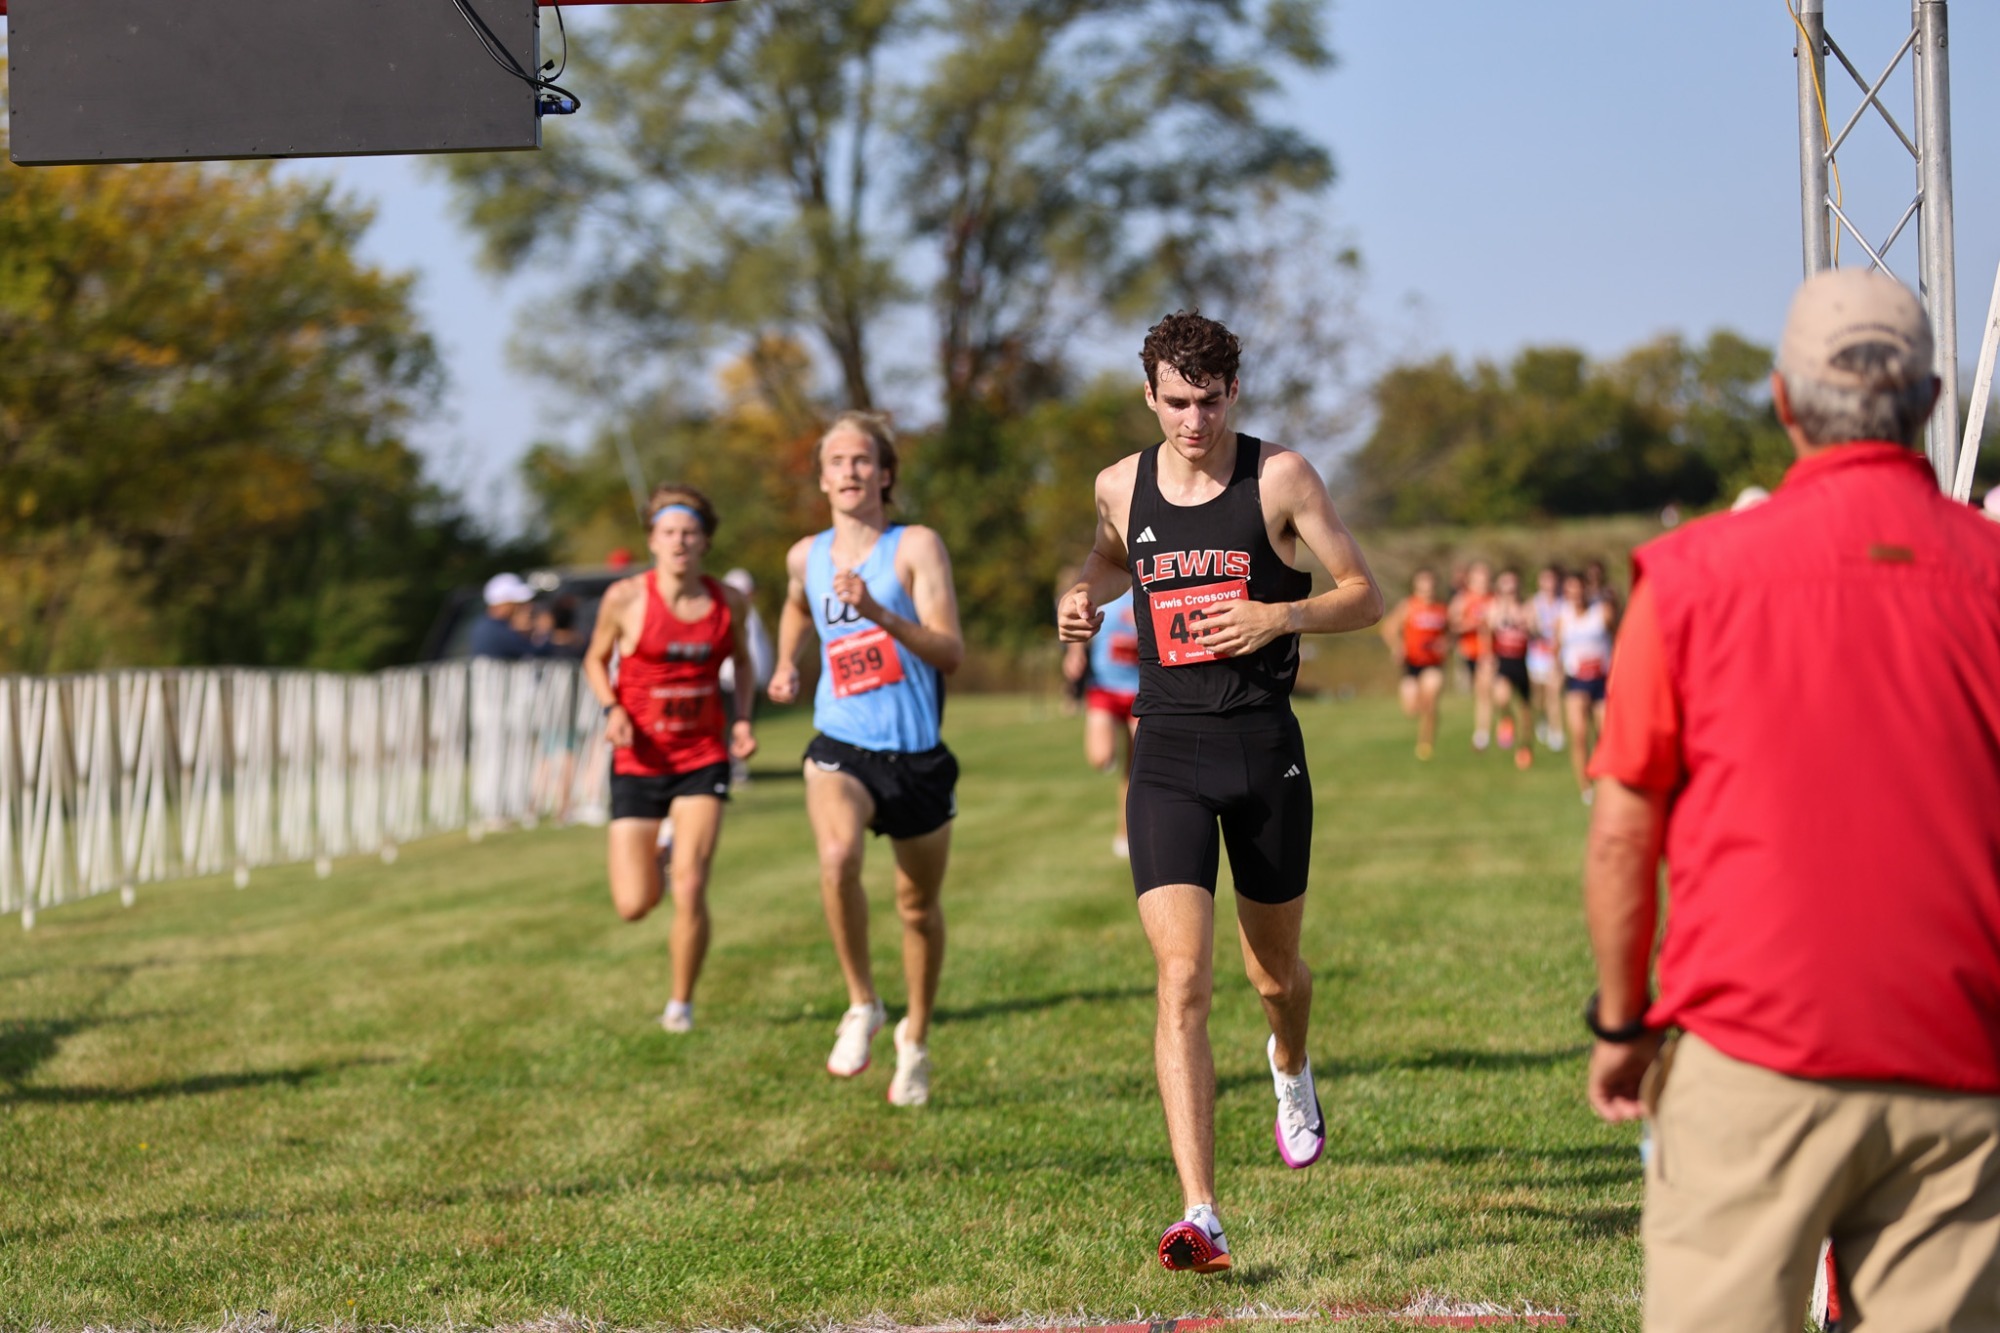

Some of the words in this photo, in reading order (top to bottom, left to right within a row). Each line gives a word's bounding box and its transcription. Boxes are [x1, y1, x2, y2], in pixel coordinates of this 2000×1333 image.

[1137, 550, 1250, 585] LEWIS
[1154, 598, 1182, 609] Lewis
[1185, 589, 1241, 604] Crossover
[837, 646, 884, 680] 559
